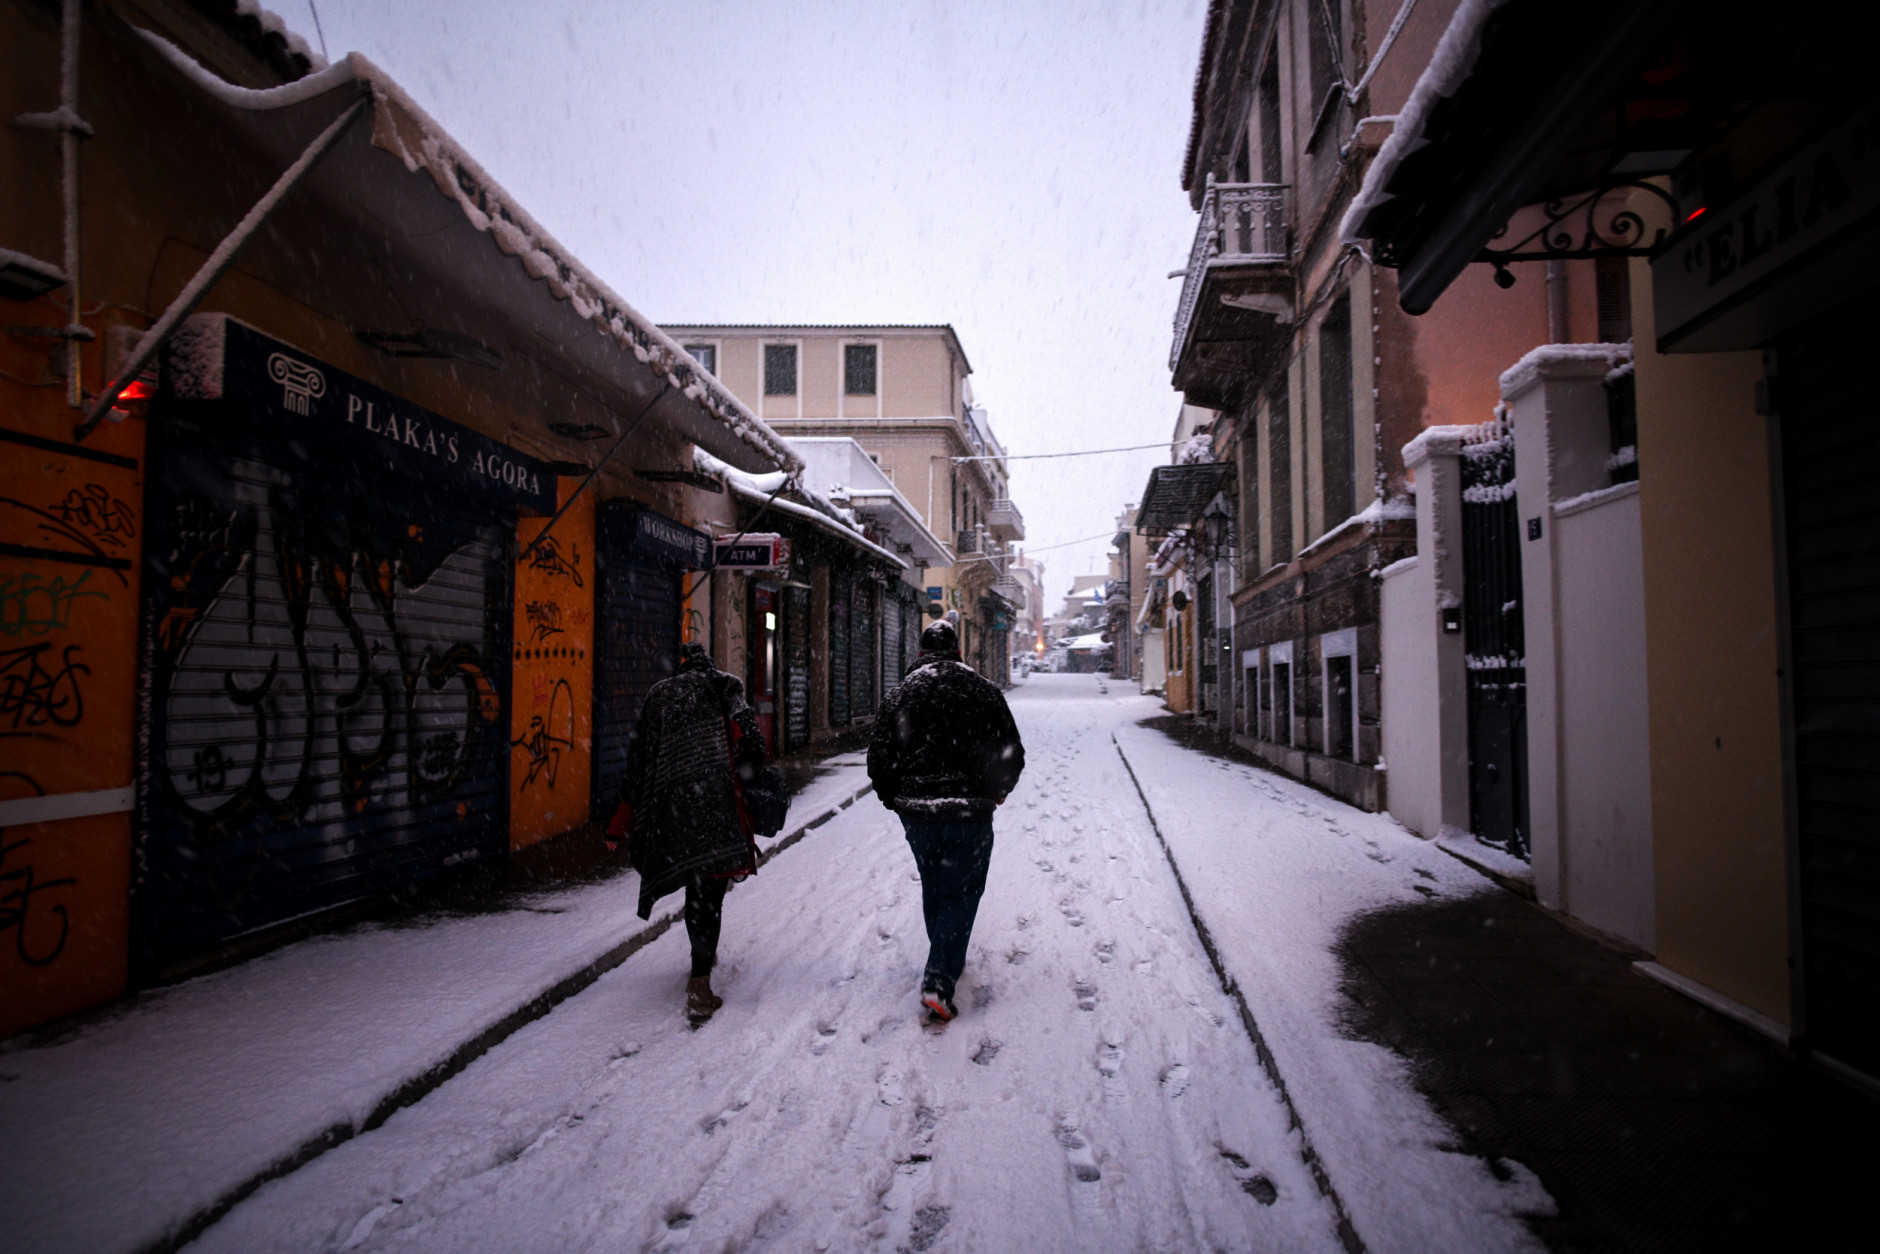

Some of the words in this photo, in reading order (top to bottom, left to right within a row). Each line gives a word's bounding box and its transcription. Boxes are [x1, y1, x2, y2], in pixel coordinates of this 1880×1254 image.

[345, 393, 460, 464] PLAKA'S
[472, 449, 541, 496] AGORA
[643, 516, 693, 552] WORKSHOP
[729, 549, 757, 561] ATM
